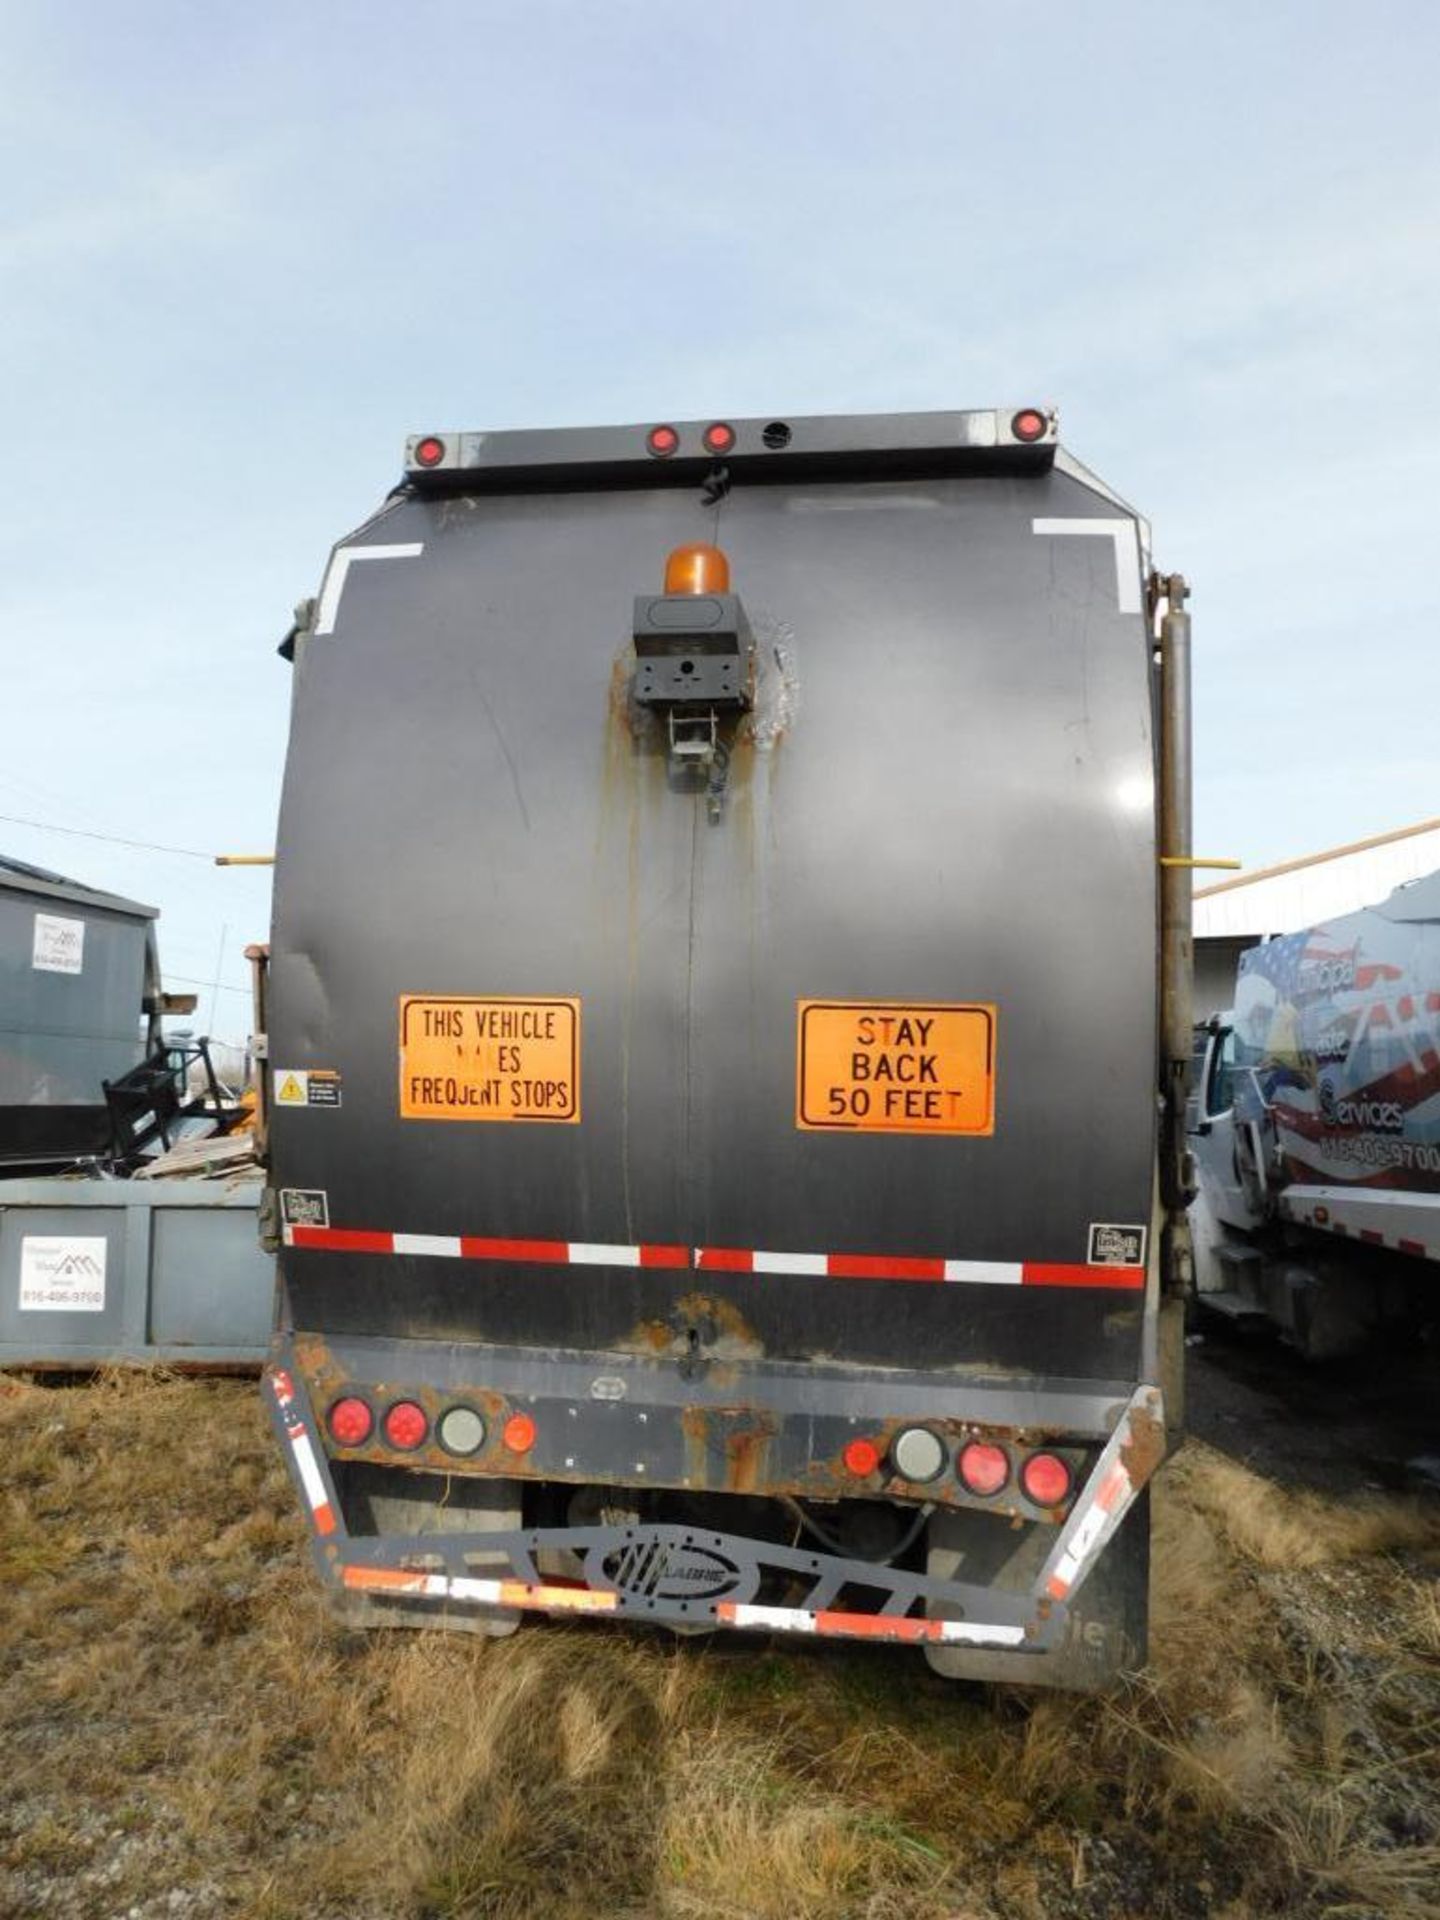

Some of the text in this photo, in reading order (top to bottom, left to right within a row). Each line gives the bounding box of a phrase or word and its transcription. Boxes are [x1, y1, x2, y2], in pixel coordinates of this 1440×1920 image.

[423, 1010, 556, 1039] THIS VEHICLE
[857, 1017, 934, 1047] STAY
[852, 1053, 938, 1083] BACK
[511, 1080, 568, 1108] STOPS
[829, 1088, 962, 1119] 50 FEET
[1320, 1078, 1404, 1127] Services
